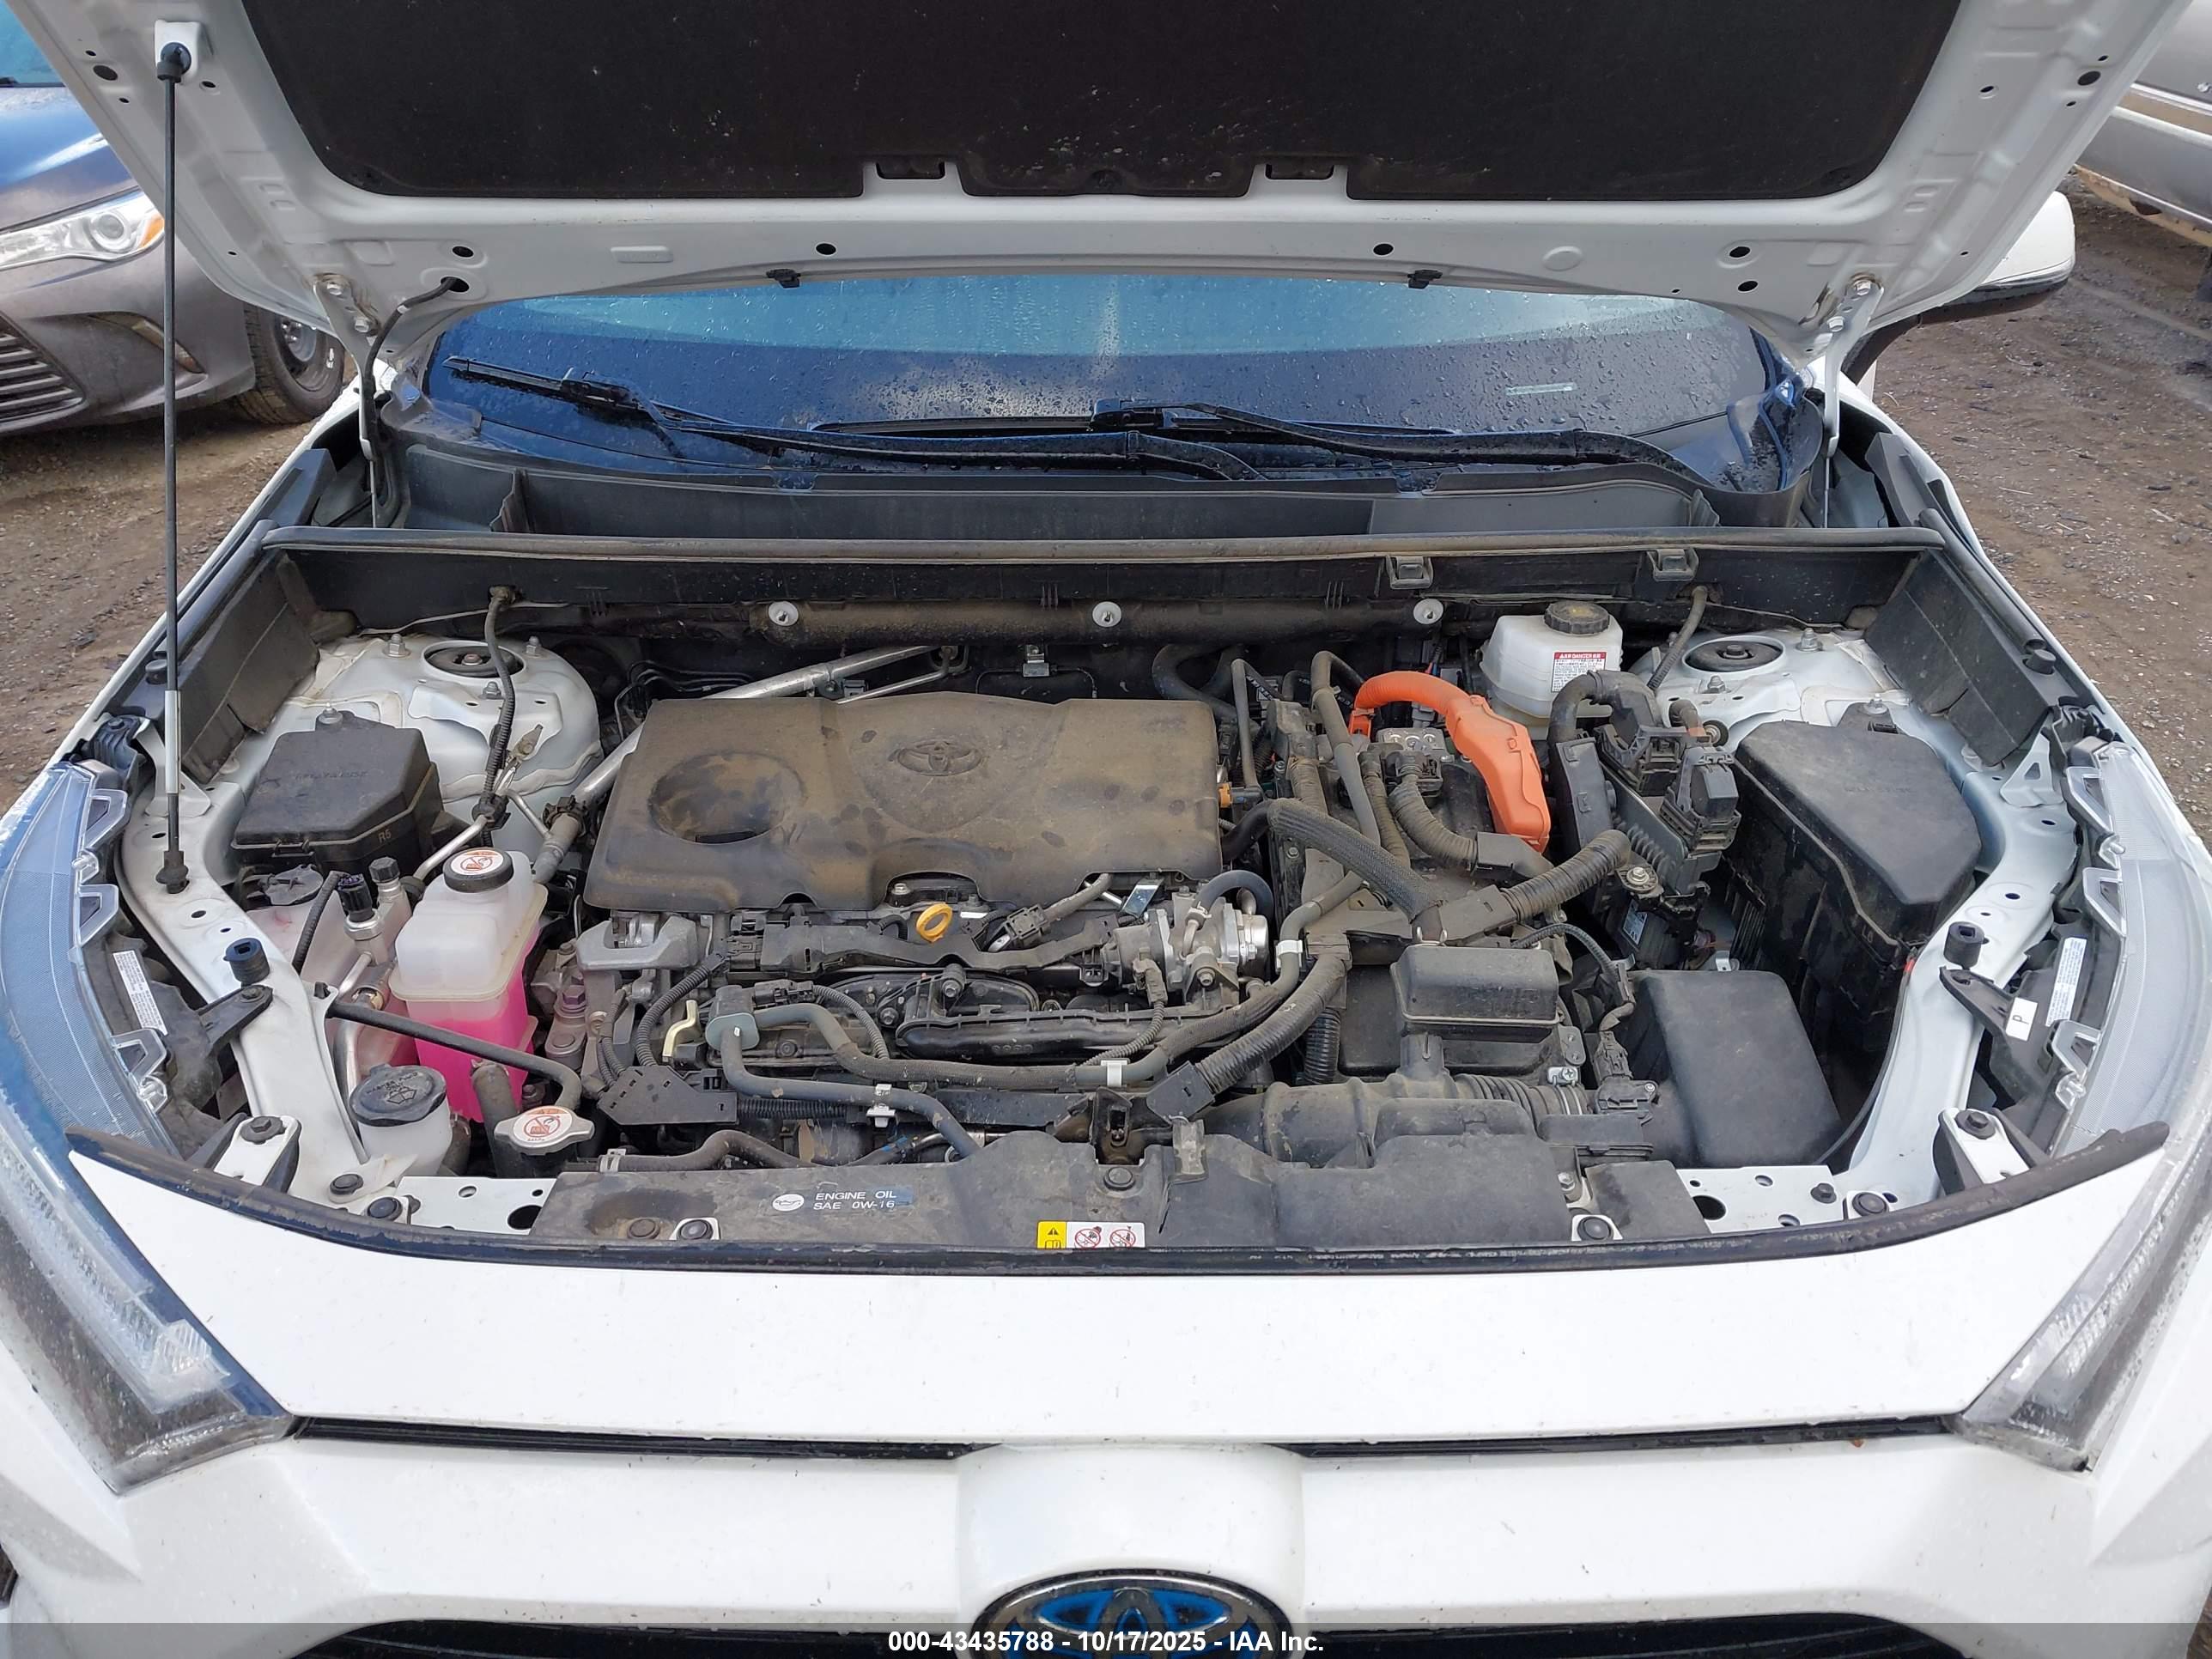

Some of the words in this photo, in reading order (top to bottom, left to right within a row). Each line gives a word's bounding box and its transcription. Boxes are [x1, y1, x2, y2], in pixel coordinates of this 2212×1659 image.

[815, 1191, 866, 1201] ENGINE
[875, 1190, 897, 1199] OIL
[812, 1201, 842, 1211] SAE
[851, 1200, 895, 1209] 0W-16
